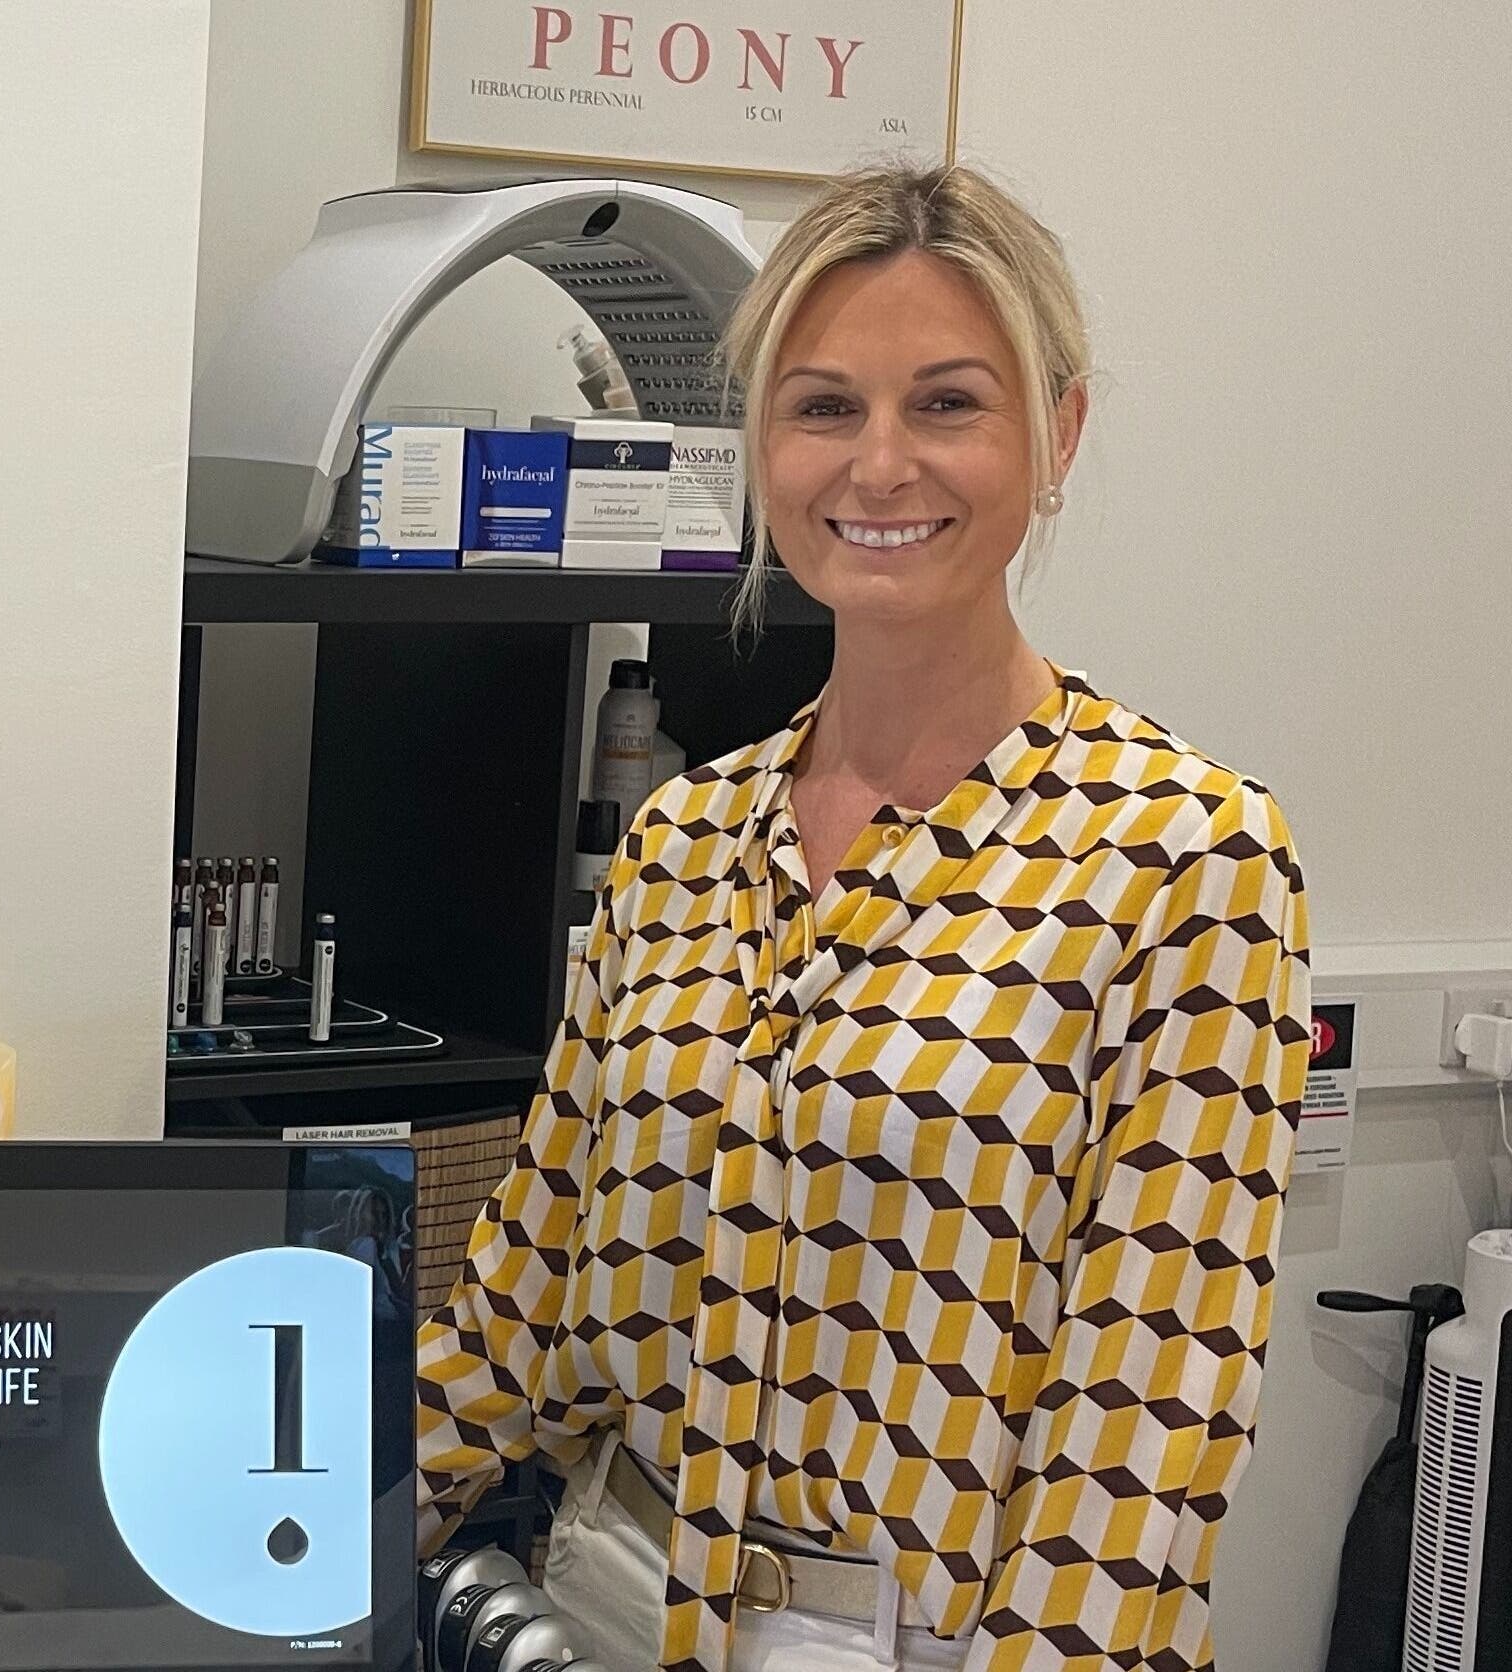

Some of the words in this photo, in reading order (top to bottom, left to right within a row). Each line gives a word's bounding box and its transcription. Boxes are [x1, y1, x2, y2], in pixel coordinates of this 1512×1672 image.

[528, 6, 865, 99] PEONY
[470, 79, 565, 103] HERBACEOUS
[569, 88, 645, 111] PERENNIAL
[744, 105, 757, 121] 15
[760, 107, 783, 123] CM
[879, 117, 908, 135] ASIA
[671, 446, 737, 464] NASSIFMD
[481, 464, 554, 486] hydrafacial
[593, 505, 640, 518] hydrafacial
[675, 525, 722, 538] hydrafacial
[295, 1131, 328, 1140] LASER
[330, 1129, 354, 1139] HAIR
[356, 1127, 400, 1138] REMOVAL
